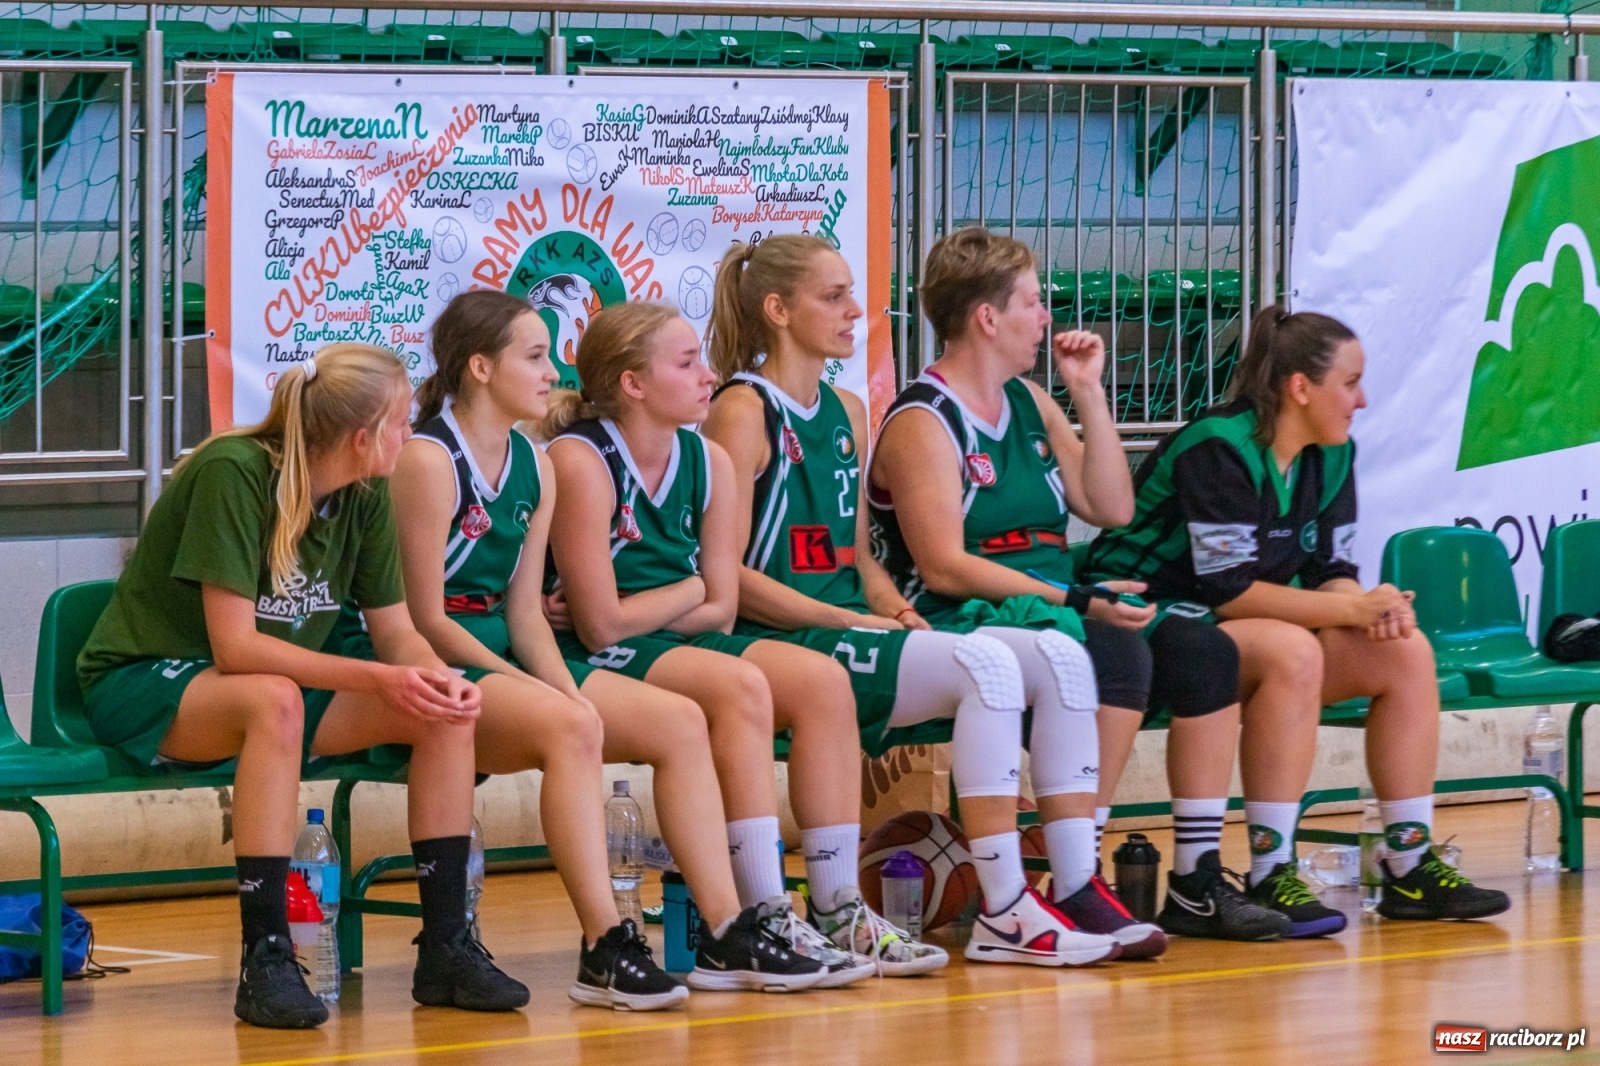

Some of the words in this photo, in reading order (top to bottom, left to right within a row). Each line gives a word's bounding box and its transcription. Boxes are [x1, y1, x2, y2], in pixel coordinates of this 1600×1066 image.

[265, 100, 428, 139] MarzenaN
[477, 104, 539, 132] Martyna
[596, 103, 646, 131] KasiaG
[645, 104, 711, 124] DominikA
[481, 123, 543, 145] MarekP
[582, 122, 640, 142] BISKU
[652, 128, 721, 148] MariolaH
[355, 138, 425, 187] JoachimL
[453, 145, 509, 165] Zuzanka
[505, 146, 544, 166] Miko
[632, 146, 691, 165] Maminka
[265, 167, 356, 188] AleksandraS
[600, 144, 635, 191] EwaK
[639, 165, 685, 186] NikolS
[692, 157, 750, 177] EwelinaS
[426, 171, 518, 190] OSKELKA
[685, 175, 756, 195] MateuszK
[279, 188, 375, 208] SenectusMed
[410, 189, 471, 208] KarinaL
[668, 187, 718, 206] Zuzanna
[755, 183, 825, 203] ArkadiuszL
[265, 209, 344, 238] GrzegorzP
[385, 228, 431, 255] Stefka
[468, 187, 548, 292] RAMY
[561, 183, 614, 241] DLA
[265, 237, 305, 267] Alicja
[384, 249, 430, 270] Kamil
[265, 260, 290, 280] Ala
[366, 231, 395, 308] IgnacyF
[516, 238, 562, 288] RKK
[573, 242, 614, 287] AZS
[326, 281, 374, 301] Dorota
[386, 270, 430, 300] AgaK
[315, 301, 371, 322] Dominik
[370, 303, 425, 324] BuszW
[293, 321, 366, 342] BartoszK
[390, 324, 424, 343] Busz
[587, 645, 637, 670] 8
